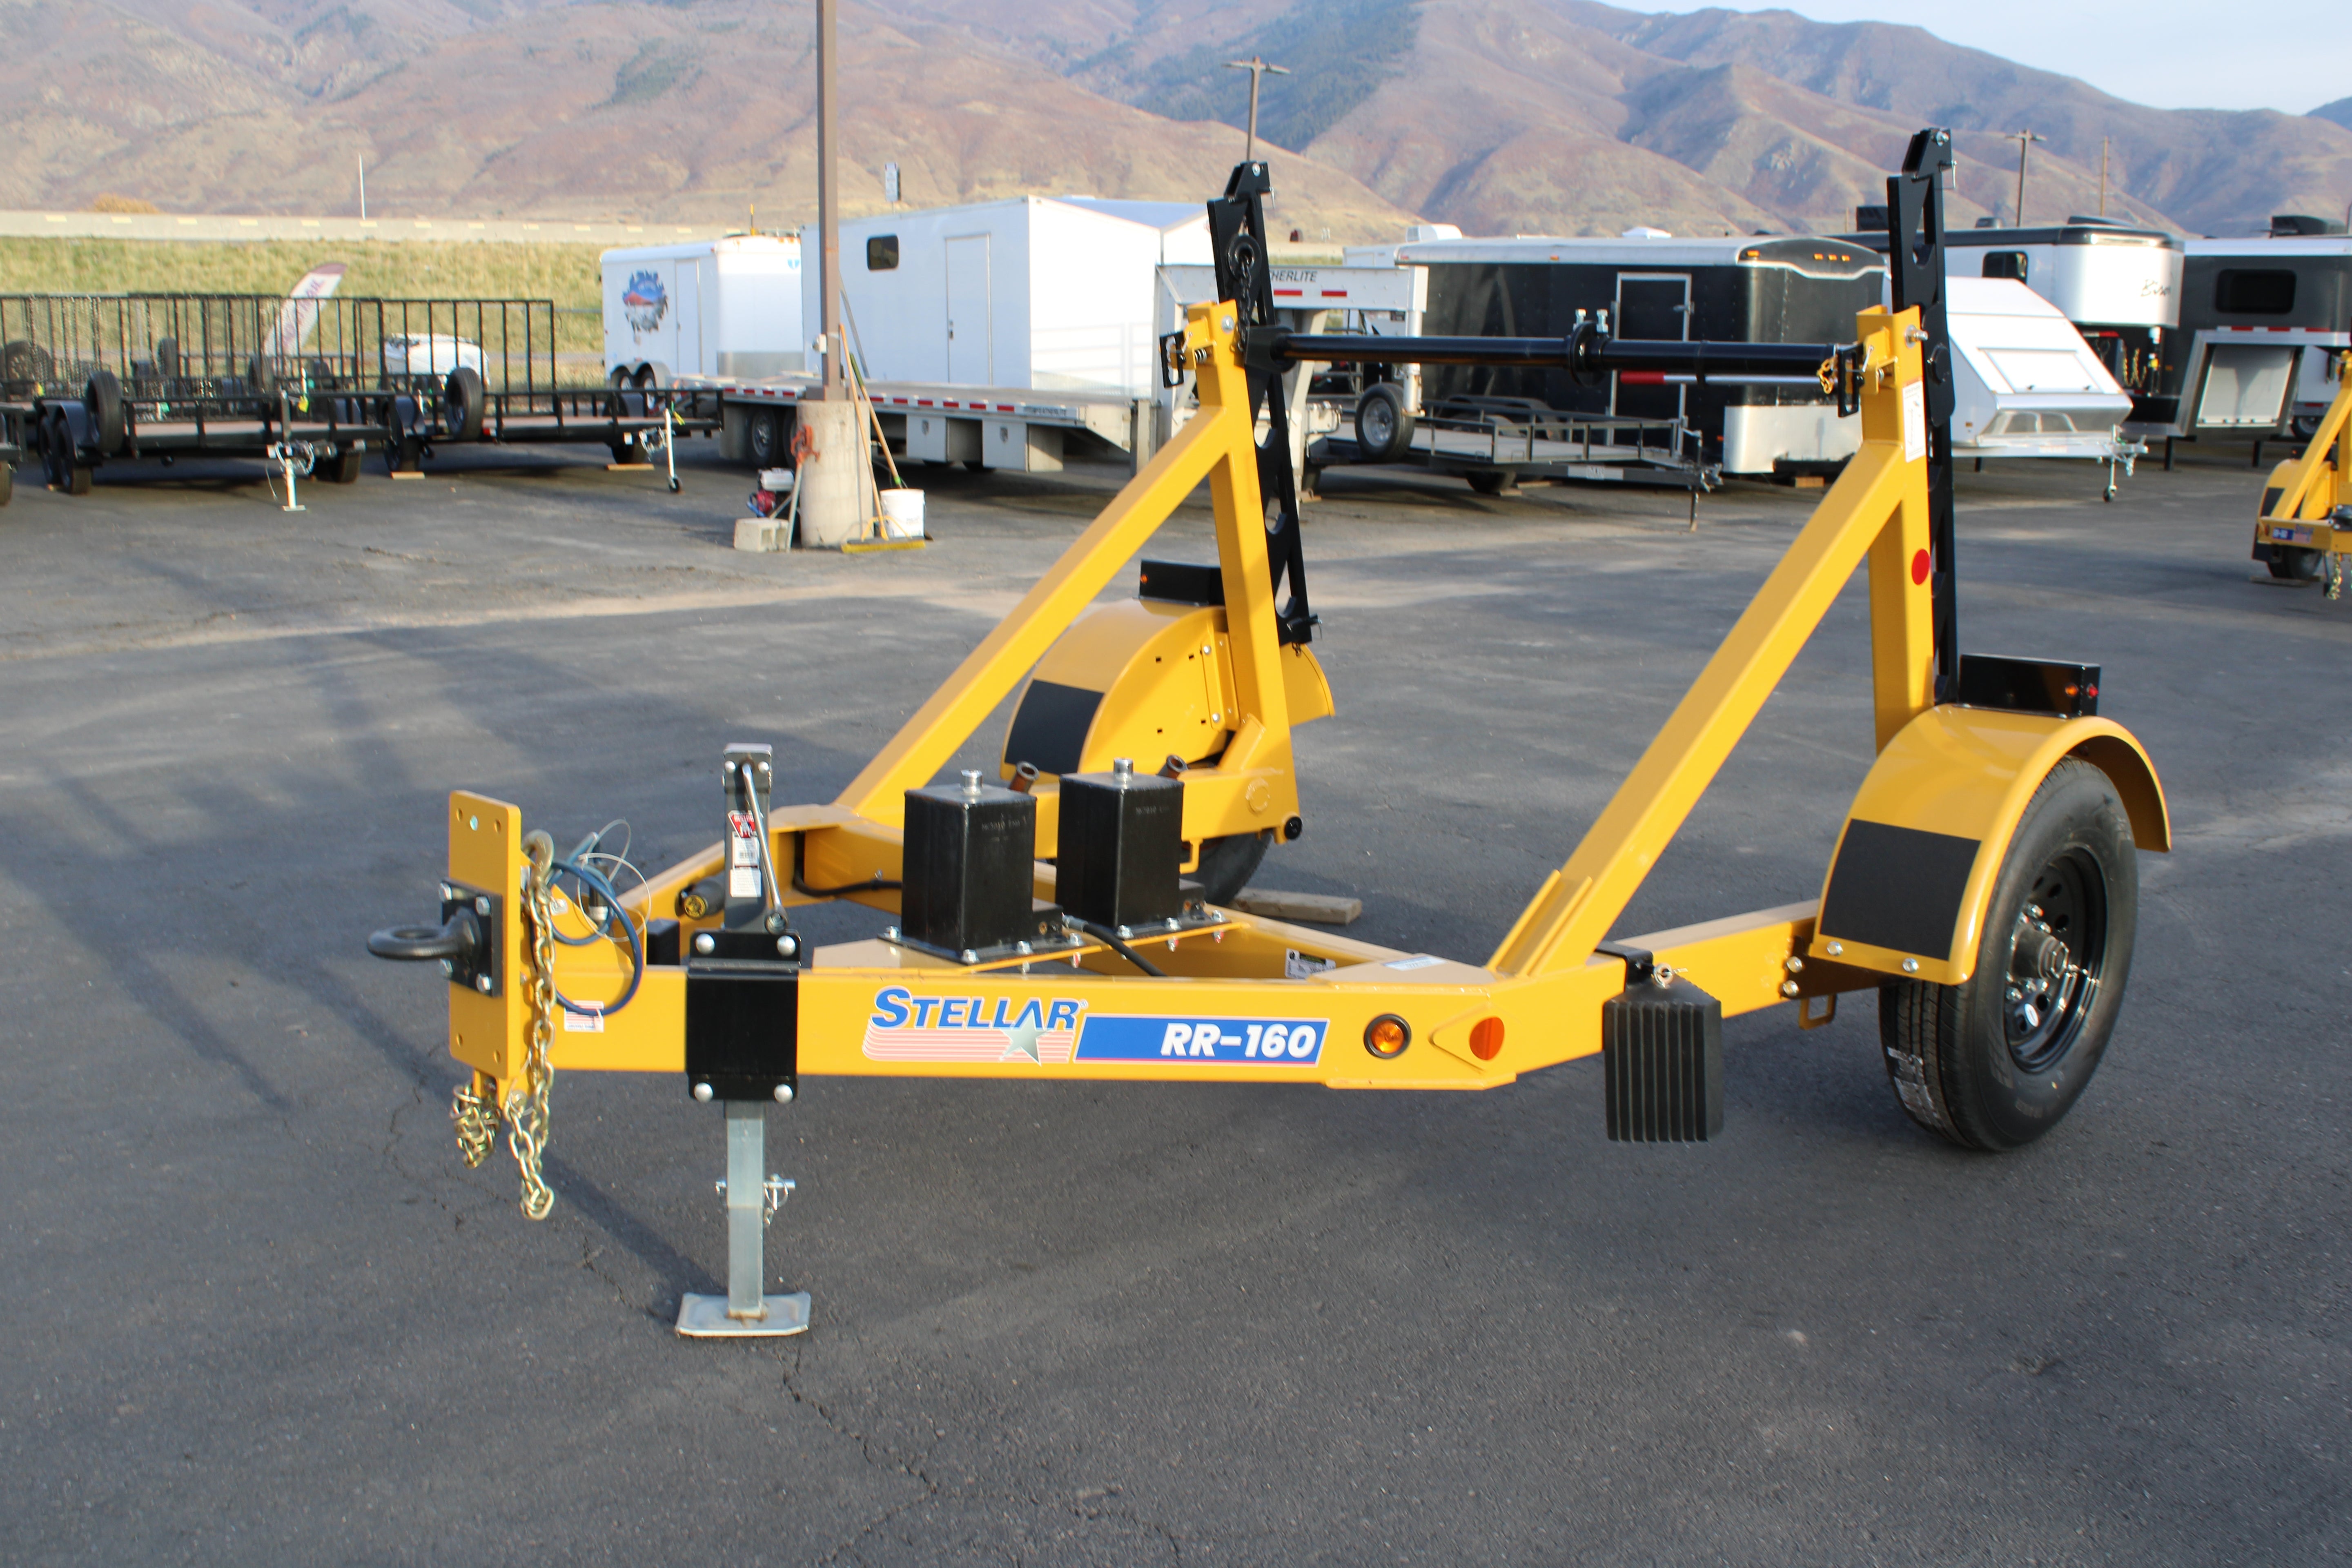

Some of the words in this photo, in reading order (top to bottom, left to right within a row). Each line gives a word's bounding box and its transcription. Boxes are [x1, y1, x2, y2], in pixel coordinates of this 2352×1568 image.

[1270, 270, 1318, 282] HERLITE
[870, 985, 1080, 1031] STELLAR
[1160, 1022, 1316, 1058] RR-160
